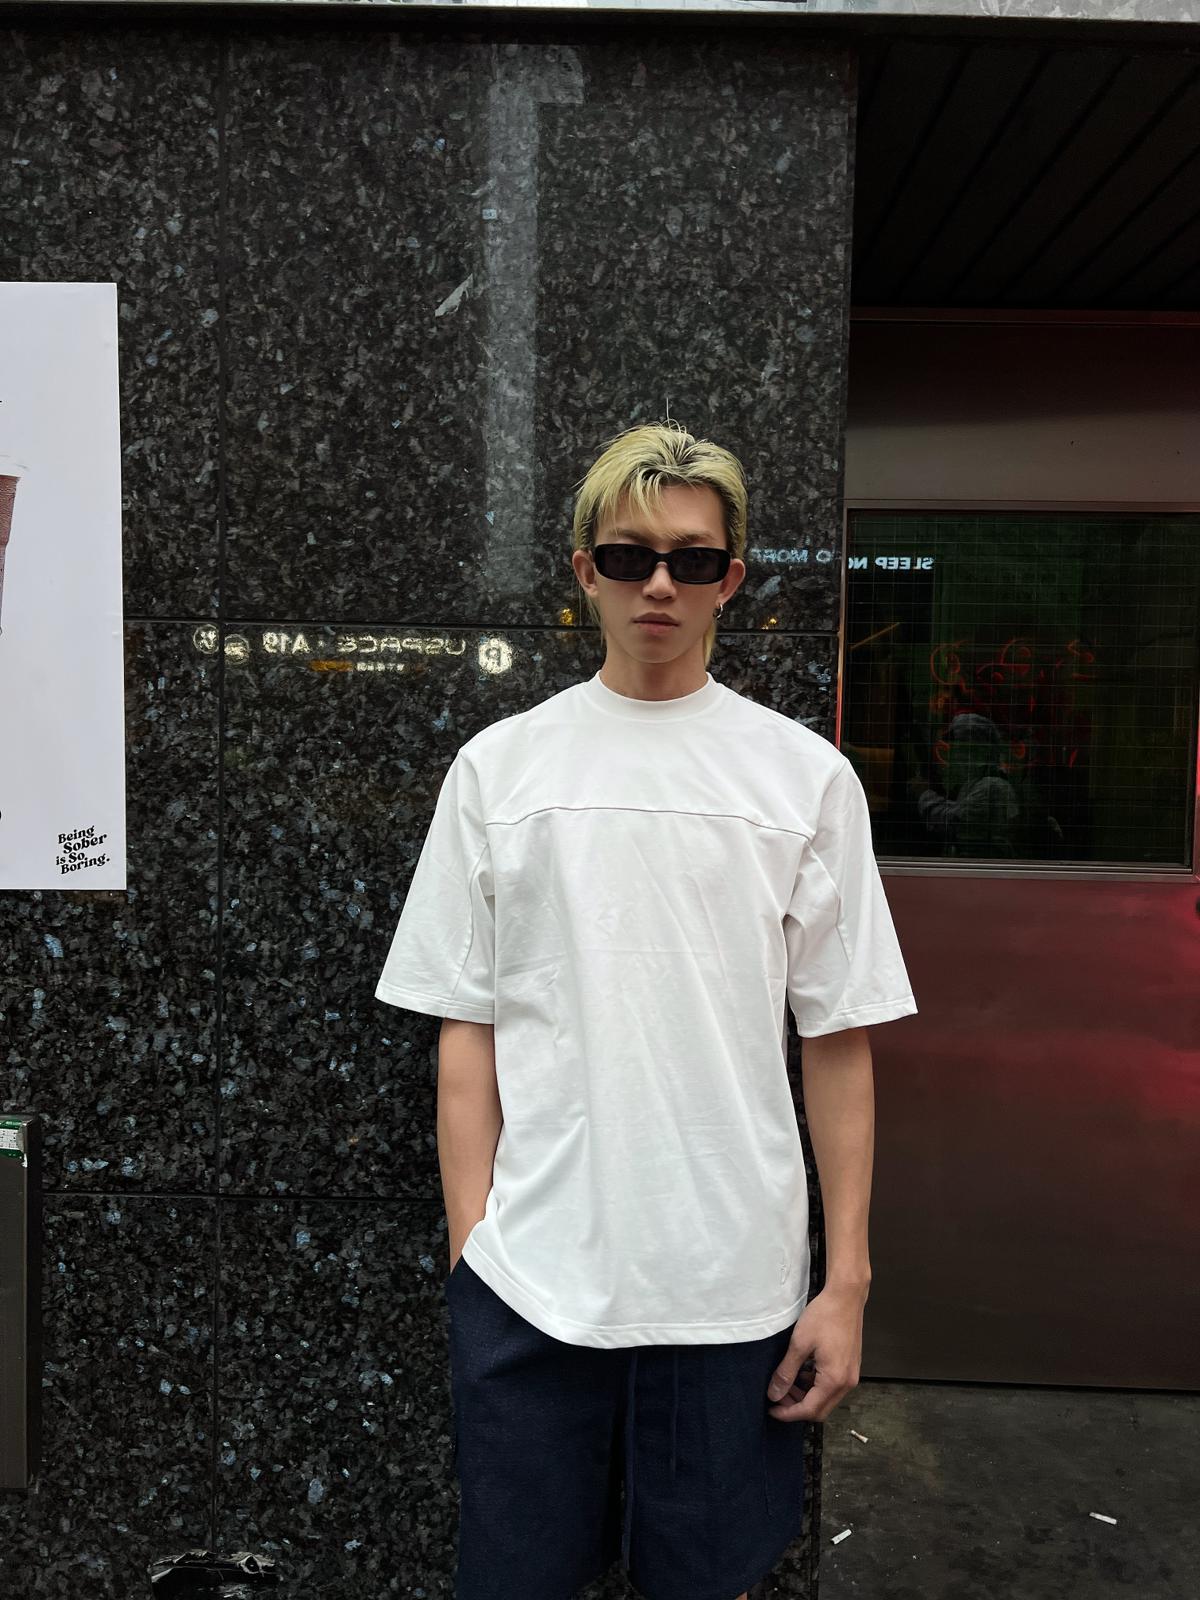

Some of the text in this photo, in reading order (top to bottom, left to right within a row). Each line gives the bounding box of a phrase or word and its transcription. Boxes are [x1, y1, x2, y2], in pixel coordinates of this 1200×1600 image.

[58, 825, 95, 844] Being
[63, 834, 107, 854] Sober
[56, 852, 85, 866] is So
[61, 853, 110, 875] Boring.
